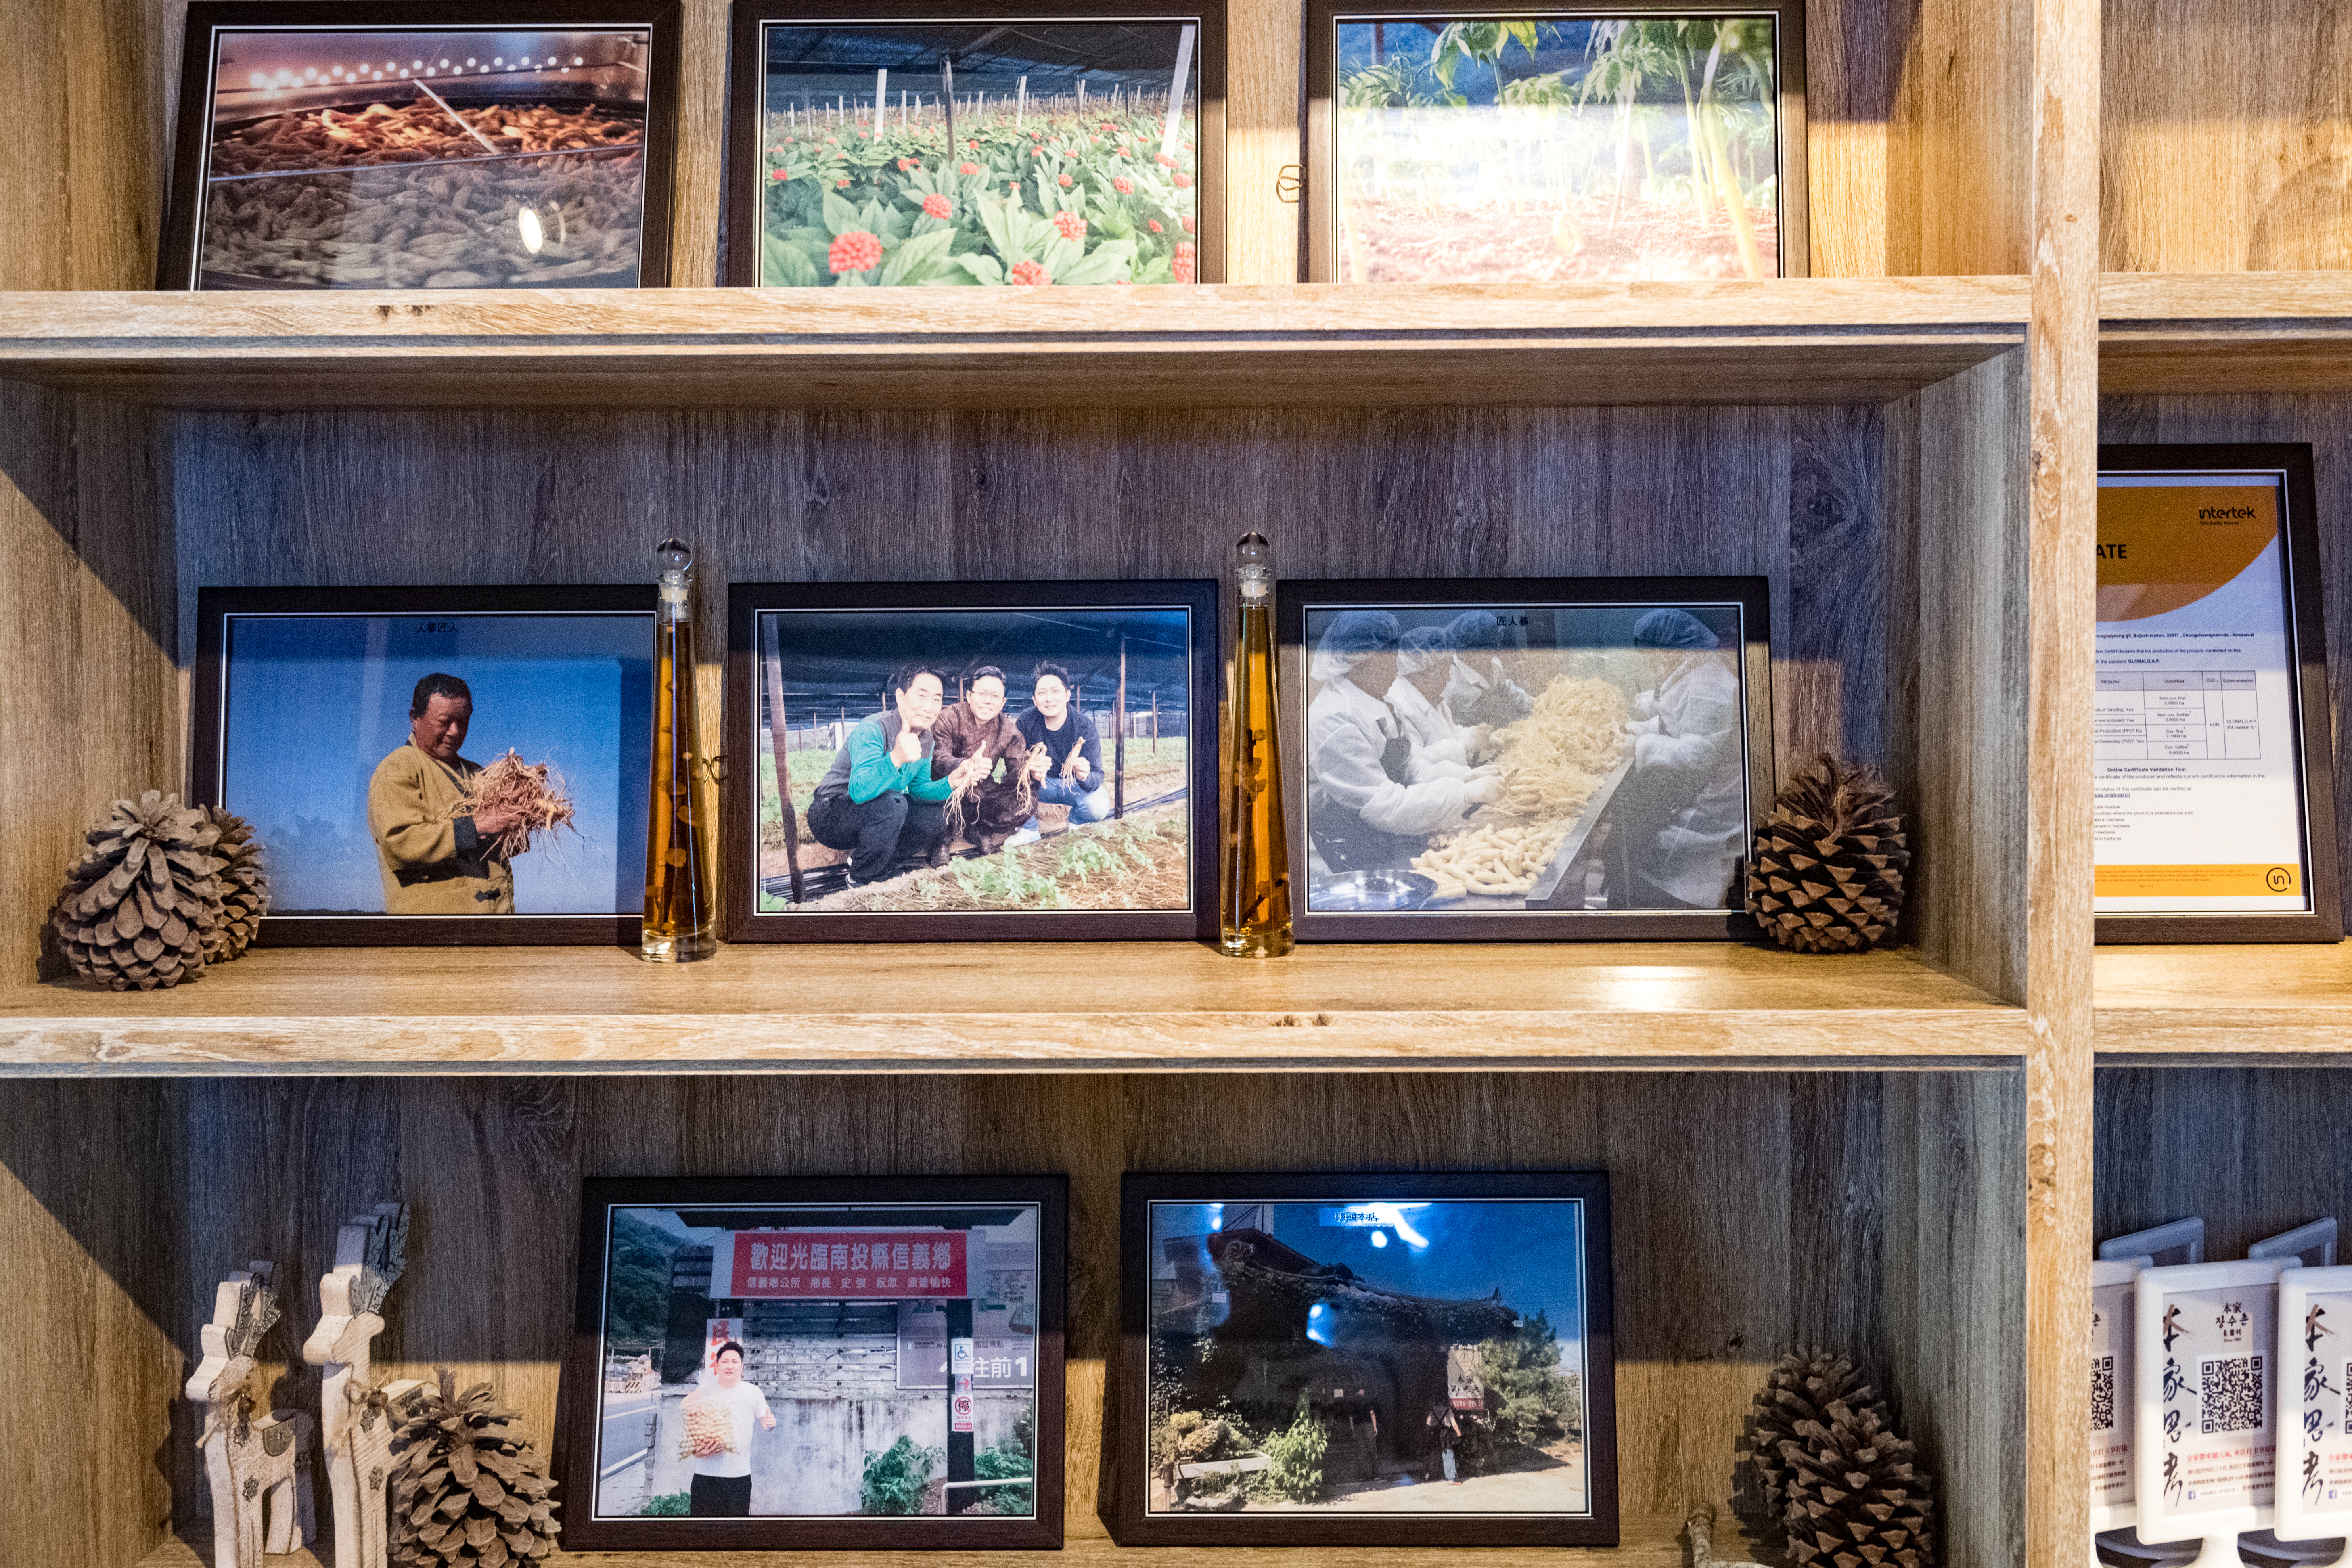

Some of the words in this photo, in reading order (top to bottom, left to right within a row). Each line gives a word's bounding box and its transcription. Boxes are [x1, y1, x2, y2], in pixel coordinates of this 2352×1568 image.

[2199, 507, 2256, 518] intertek
[751, 1242, 951, 1271] 歡迎光臨南投縣信義鄉
[2222, 1302, 2242, 1314] 本家
[2216, 1313, 2249, 1329] 장수촌
